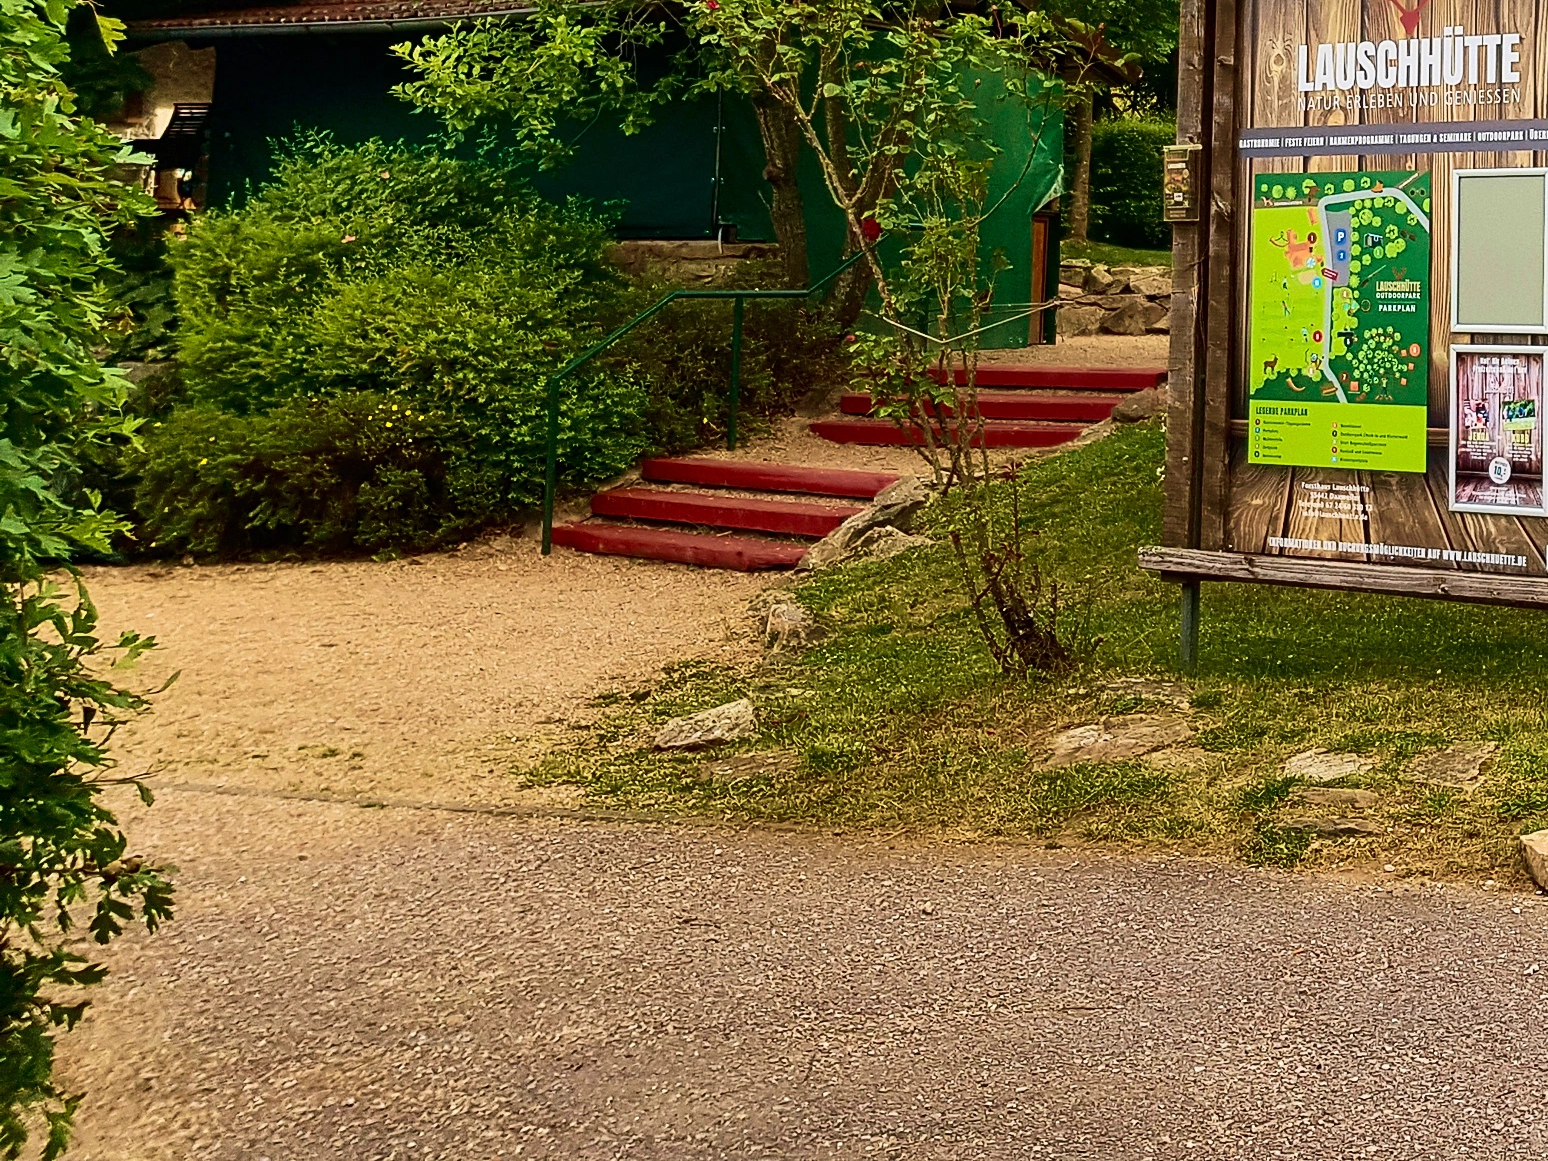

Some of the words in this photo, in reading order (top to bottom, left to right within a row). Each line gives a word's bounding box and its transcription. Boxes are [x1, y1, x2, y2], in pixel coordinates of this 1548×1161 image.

[1298, 26, 1520, 91] LAUSCHHÜTTE
[1297, 95, 1340, 112] NATUR
[1346, 92, 1403, 109] ERLEBEN
[1409, 90, 1438, 107] UND
[1443, 87, 1521, 106] GENIESSEN
[1238, 138, 1280, 149] GASTRONOMIE
[1284, 137, 1303, 148] FESTE
[1303, 136, 1324, 147] FEIERN
[1329, 134, 1394, 146] RAHMENPROGRAMME
[1399, 133, 1431, 144] TAGUNGEN
[1439, 132, 1472, 143] SEMINARE
[1477, 131, 1524, 142] OUTDOORPARK
[1375, 278, 1421, 292] LAUSCHHÜTTE
[1378, 304, 1416, 312] PARKPLAN
[1255, 406, 1279, 416] LEGENDE
[1280, 407, 1308, 416] PARKPLAN
[1269, 537, 1321, 550] INFORMATIONEN
[1323, 540, 1337, 551] UND
[1427, 548, 1441, 560] AUF
[1442, 549, 1527, 567] WWW.LAUSCHHUETTE.DE
